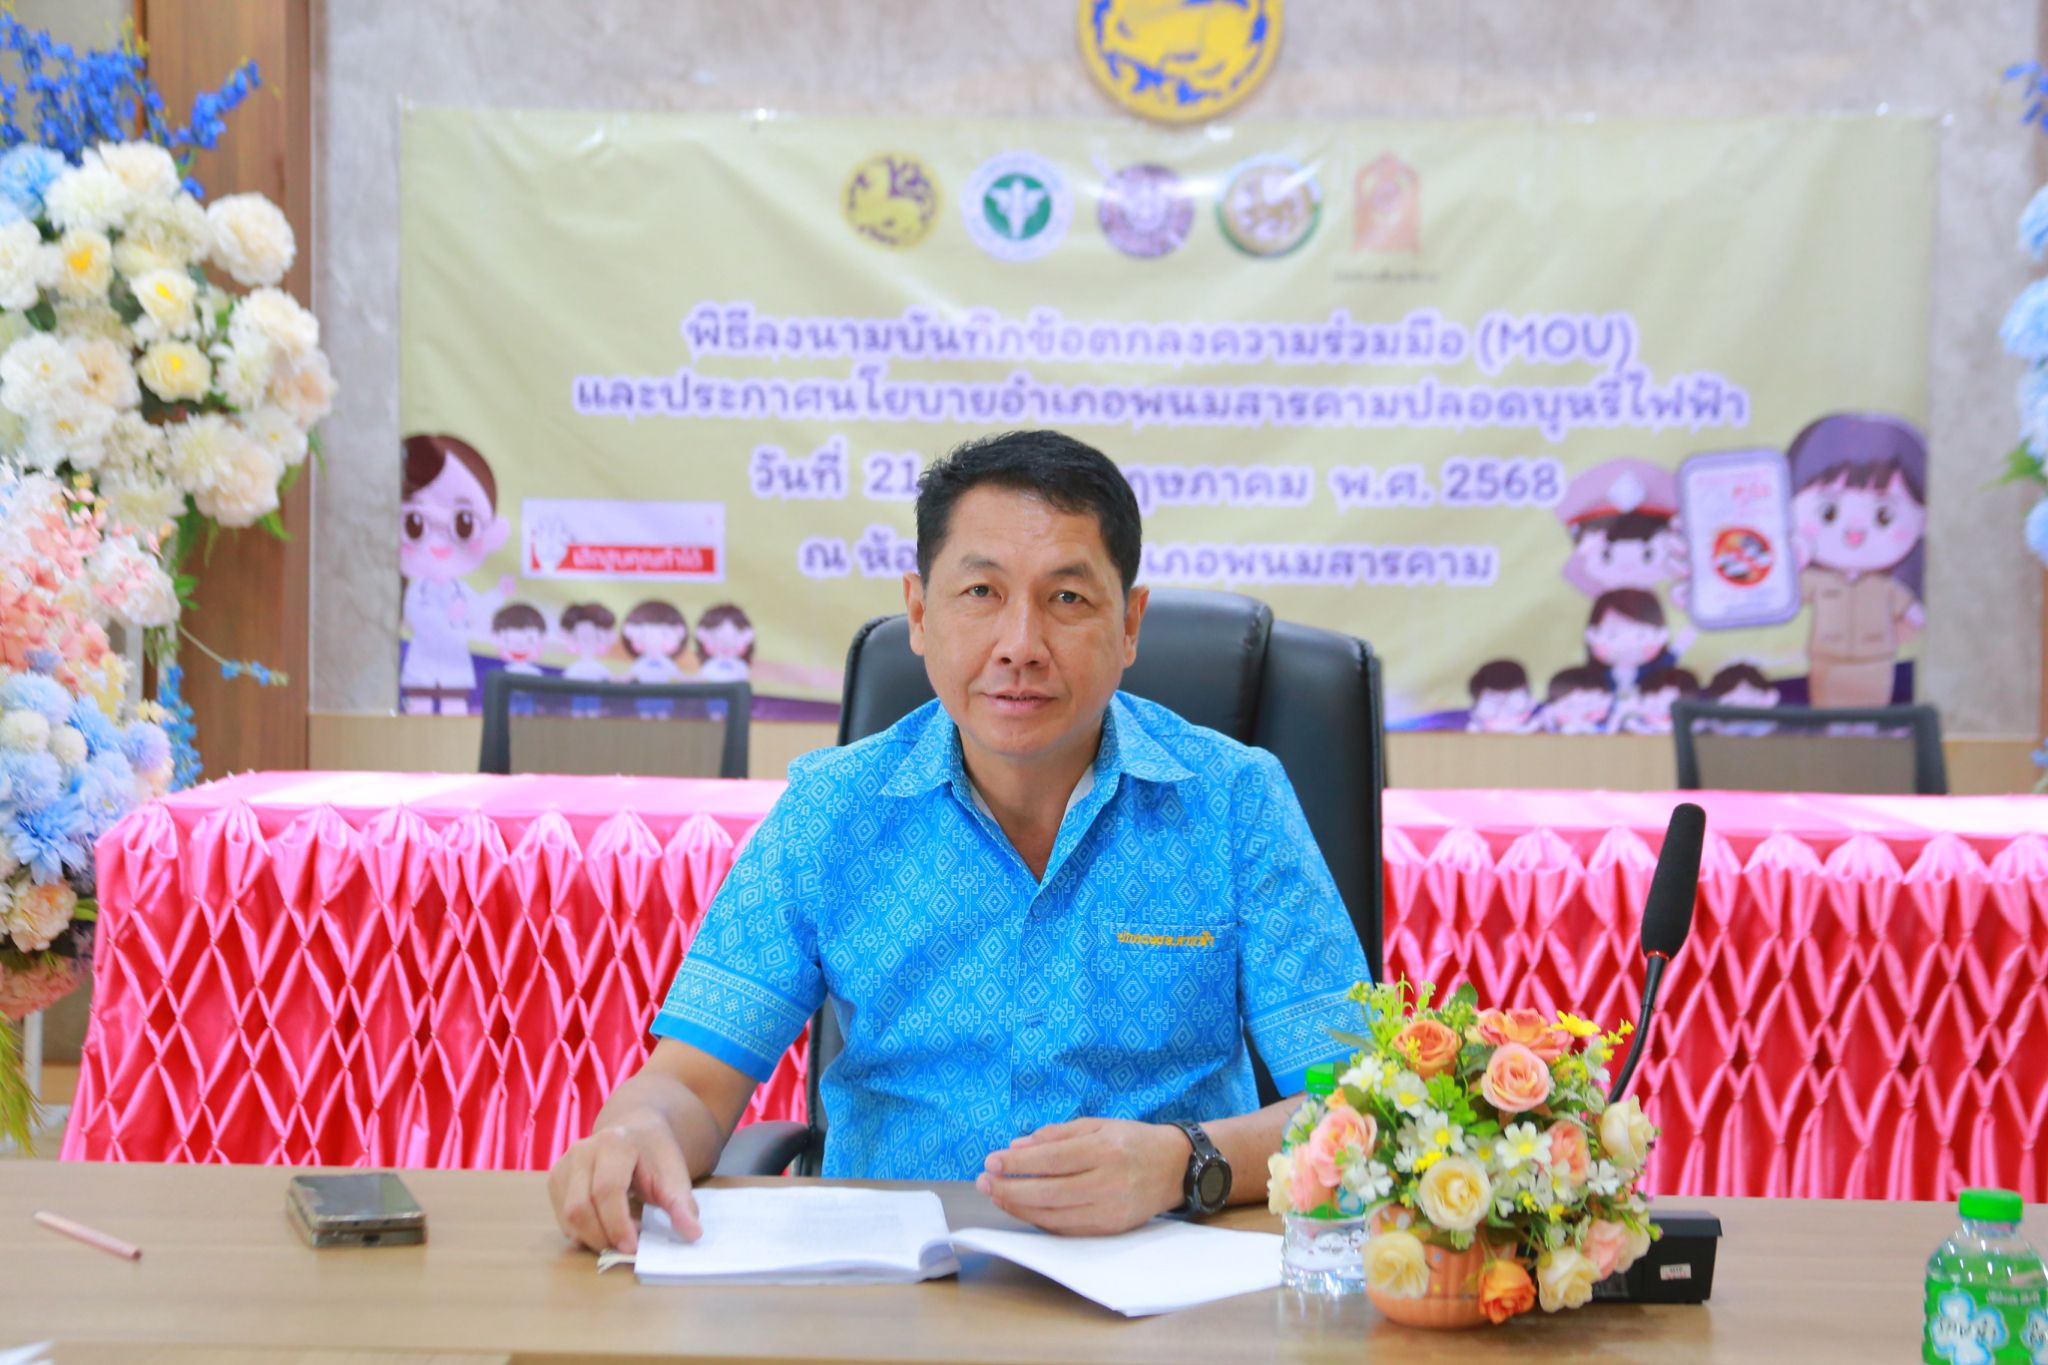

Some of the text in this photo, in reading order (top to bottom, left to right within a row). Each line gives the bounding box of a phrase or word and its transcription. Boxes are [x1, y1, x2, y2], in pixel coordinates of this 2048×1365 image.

[1479, 316, 1632, 374] (MOU)
[756, 441, 841, 493] วันที่
[870, 456, 917, 494] 21
[1127, 469, 1308, 510] ฤษภาคม
[1447, 463, 1559, 502] 2568
[805, 529, 1492, 580] ณ ห้อ เภอพนมสารคาม
